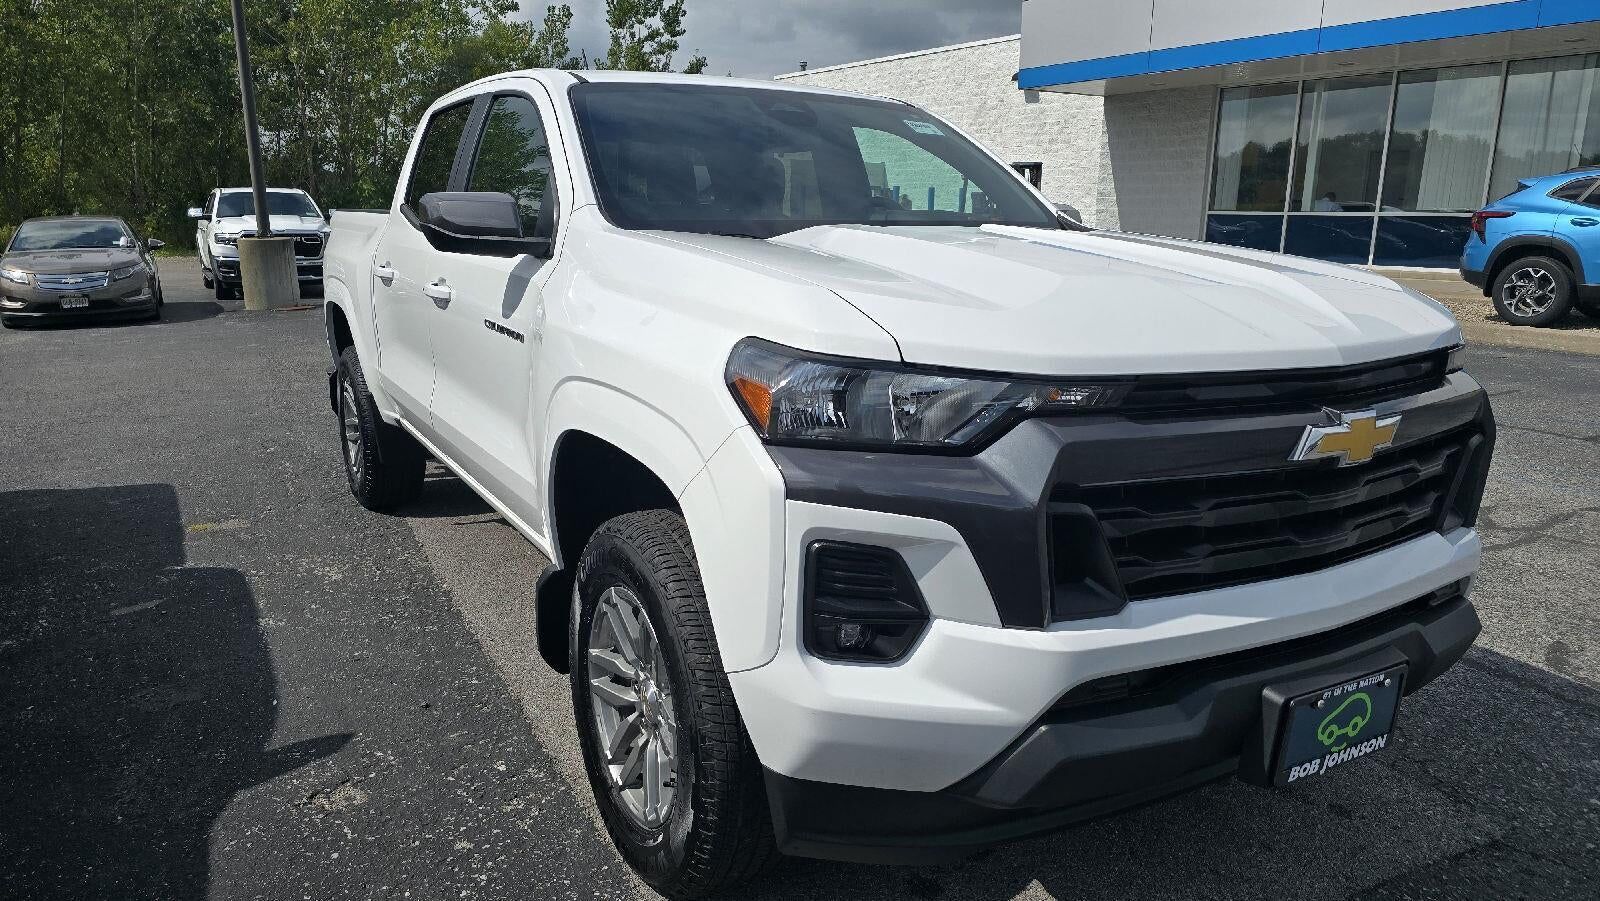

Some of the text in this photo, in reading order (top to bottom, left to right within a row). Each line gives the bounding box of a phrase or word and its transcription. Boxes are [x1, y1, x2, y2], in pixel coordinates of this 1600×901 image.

[1333, 687, 1342, 696] IN
[1343, 682, 1358, 693] THE
[1359, 673, 1385, 689] NATION
[1288, 733, 1388, 783] BOB JOHNSON
